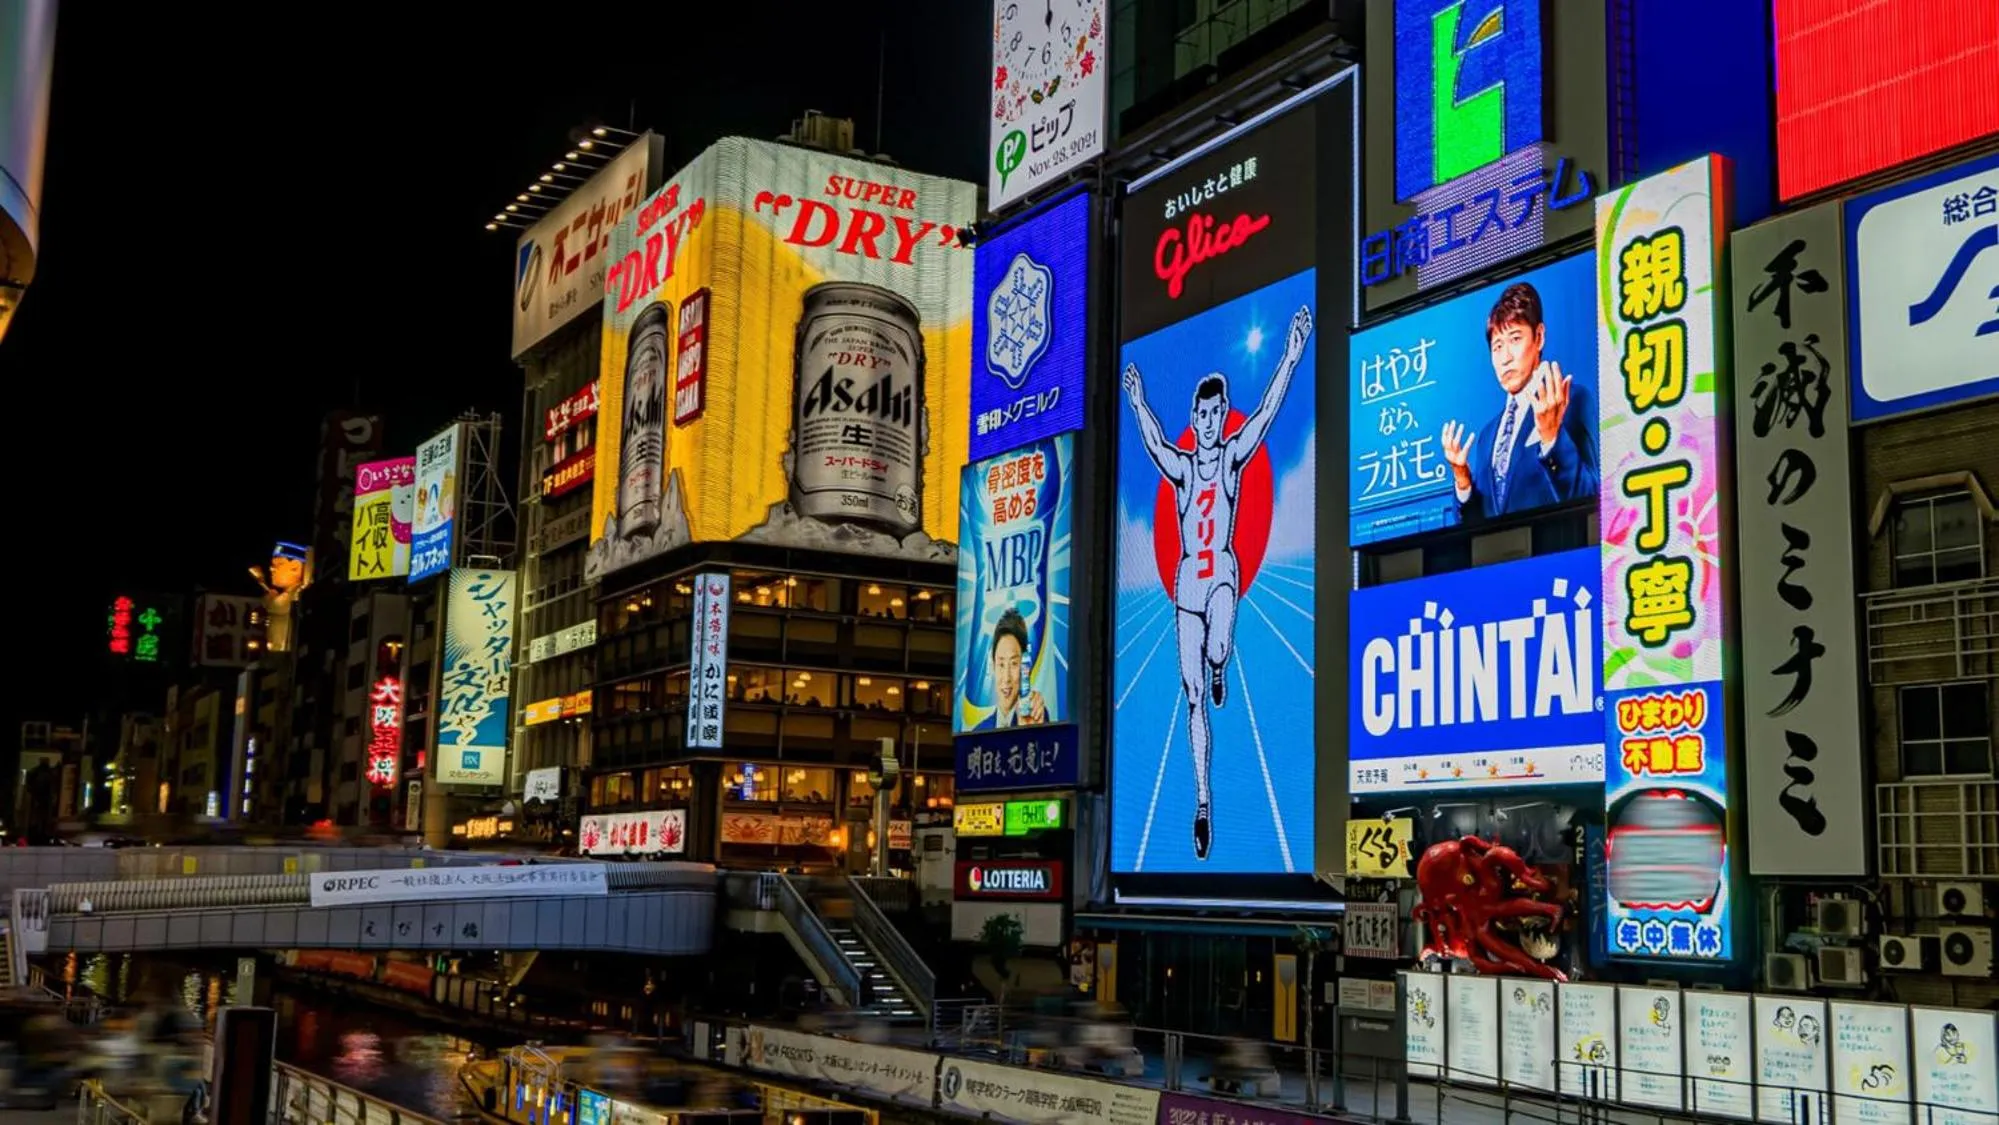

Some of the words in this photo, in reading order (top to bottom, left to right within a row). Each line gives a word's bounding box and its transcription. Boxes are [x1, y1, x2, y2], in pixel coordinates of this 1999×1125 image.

[1010, 31, 1023, 52] 8
[1024, 46, 1036, 67] 7
[1042, 41, 1052, 65] 6
[1031, 98, 1077, 153] ピップ
[636, 183, 680, 237] SUPER
[824, 173, 917, 210] SUPER
[1164, 156, 1258, 220] おいしさと健康
[549, 167, 644, 285] 不二サッシ
[1361, 157, 1592, 287] 日商エステム
[1154, 213, 1271, 299] Glico
[1361, 338, 1437, 400] はやす
[803, 365, 912, 428] Asahi
[976, 387, 1060, 436] 雪印メグミルク
[1378, 402, 1419, 436] なら、
[841, 424, 873, 447] 生
[1619, 226, 1696, 649] 親切・丁寧
[987, 452, 1045, 497] 骨密度を
[1358, 436, 1447, 495] ラボモ。
[841, 494, 869, 508] 350ml
[993, 488, 1037, 526] 高める
[356, 505, 373, 577] バイト
[1196, 482, 1217, 580] グリコ
[1746, 238, 1831, 837] 不滅のミナミ
[986, 529, 1041, 592] MBP
[1361, 578, 1594, 737] CHINTAI
[1618, 690, 1707, 734] ひまわり
[1622, 734, 1704, 776] 不動産
[1358, 827, 1399, 869] くくる
[983, 869, 1045, 889] LOTTERIA
[364, 921, 479, 939] えびす橋
[1617, 918, 1721, 957] 年中無休
